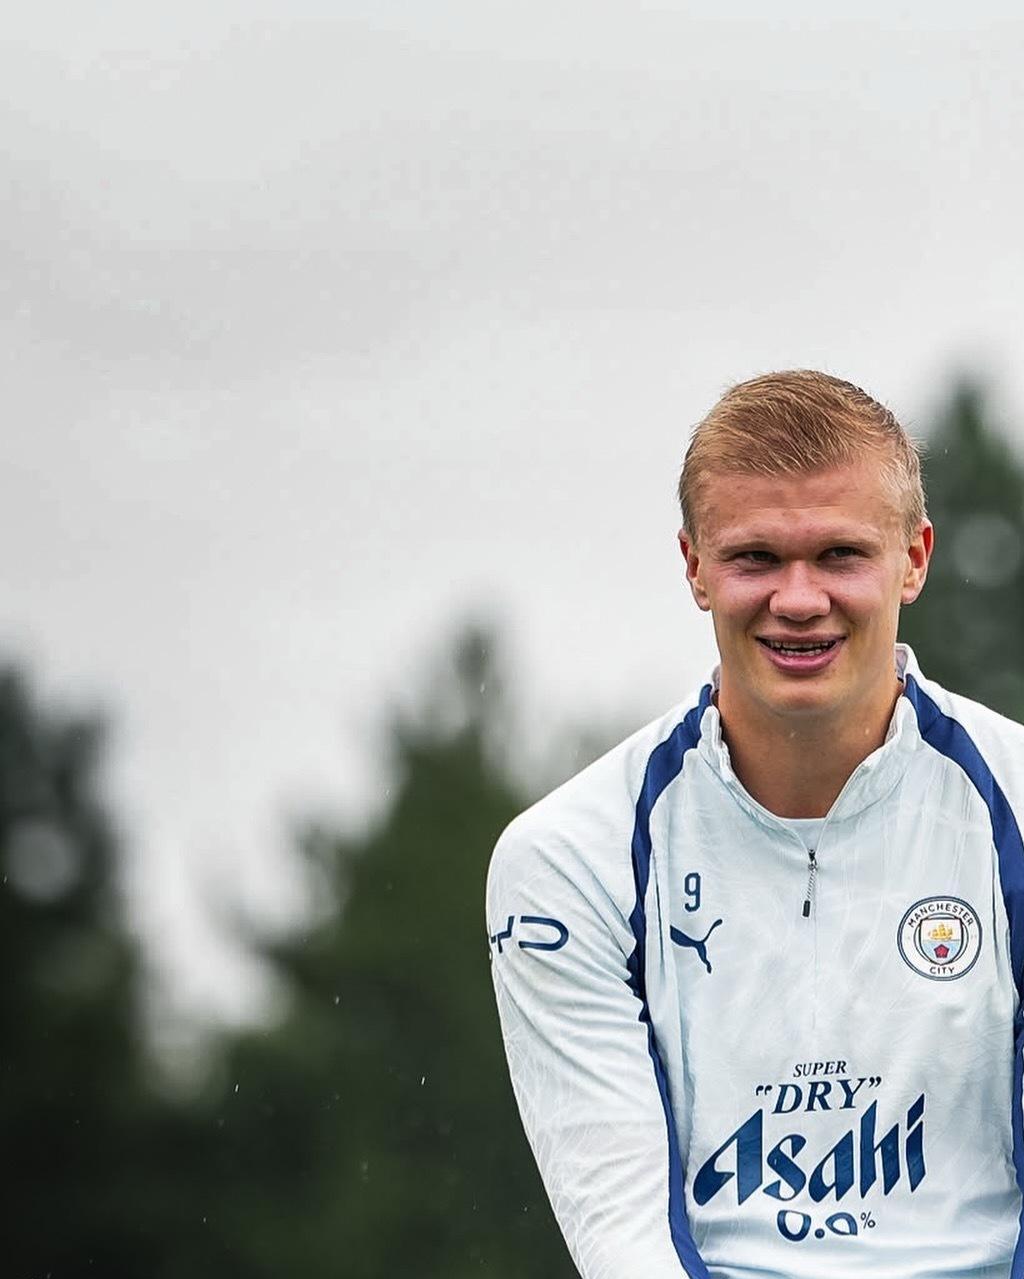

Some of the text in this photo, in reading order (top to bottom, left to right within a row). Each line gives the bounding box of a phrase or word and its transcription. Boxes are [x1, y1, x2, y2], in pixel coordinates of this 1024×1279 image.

[684, 872, 701, 913] 9
[908, 903, 974, 928] MANCHESTER
[491, 915, 569, 954] YD
[929, 966, 955, 975] CITY
[793, 1060, 848, 1078] SUPER
[693, 1093, 927, 1207] Asahi
